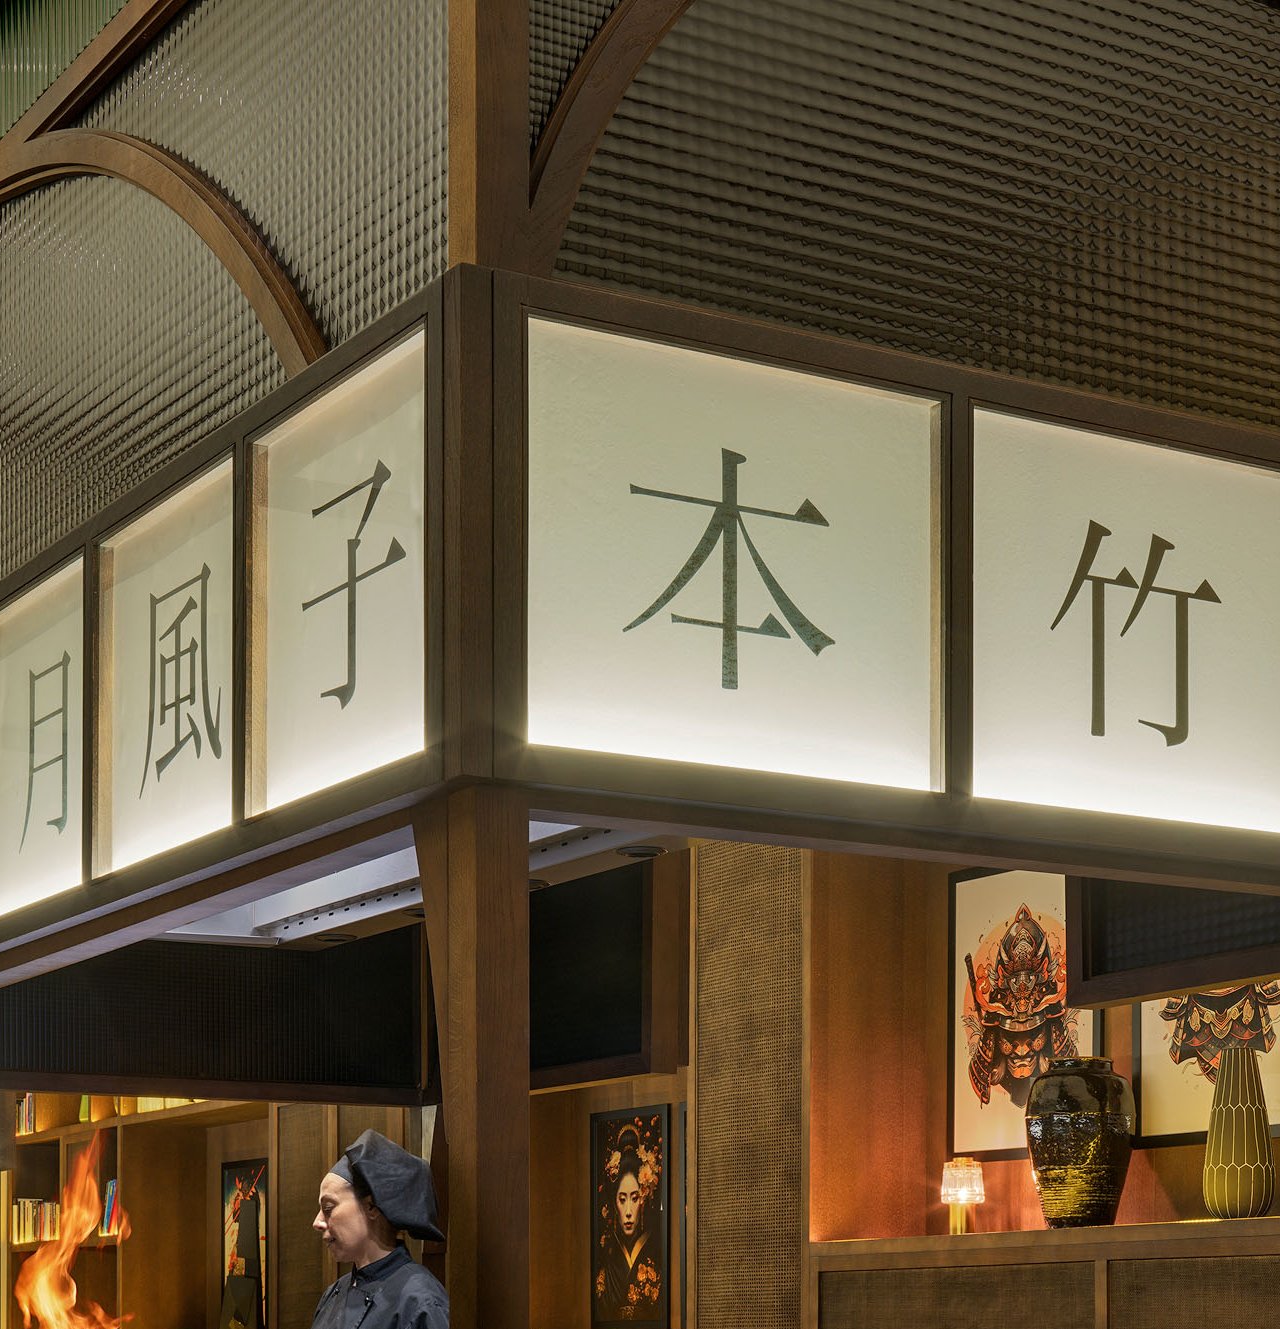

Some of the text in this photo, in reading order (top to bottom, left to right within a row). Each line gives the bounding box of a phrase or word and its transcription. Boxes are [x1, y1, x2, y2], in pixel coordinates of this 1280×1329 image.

[139, 562, 223, 800] 風
[302, 459, 407, 711] 子
[622, 448, 836, 690] 本
[1050, 519, 1222, 747] 竹
[19, 649, 72, 854] 月
